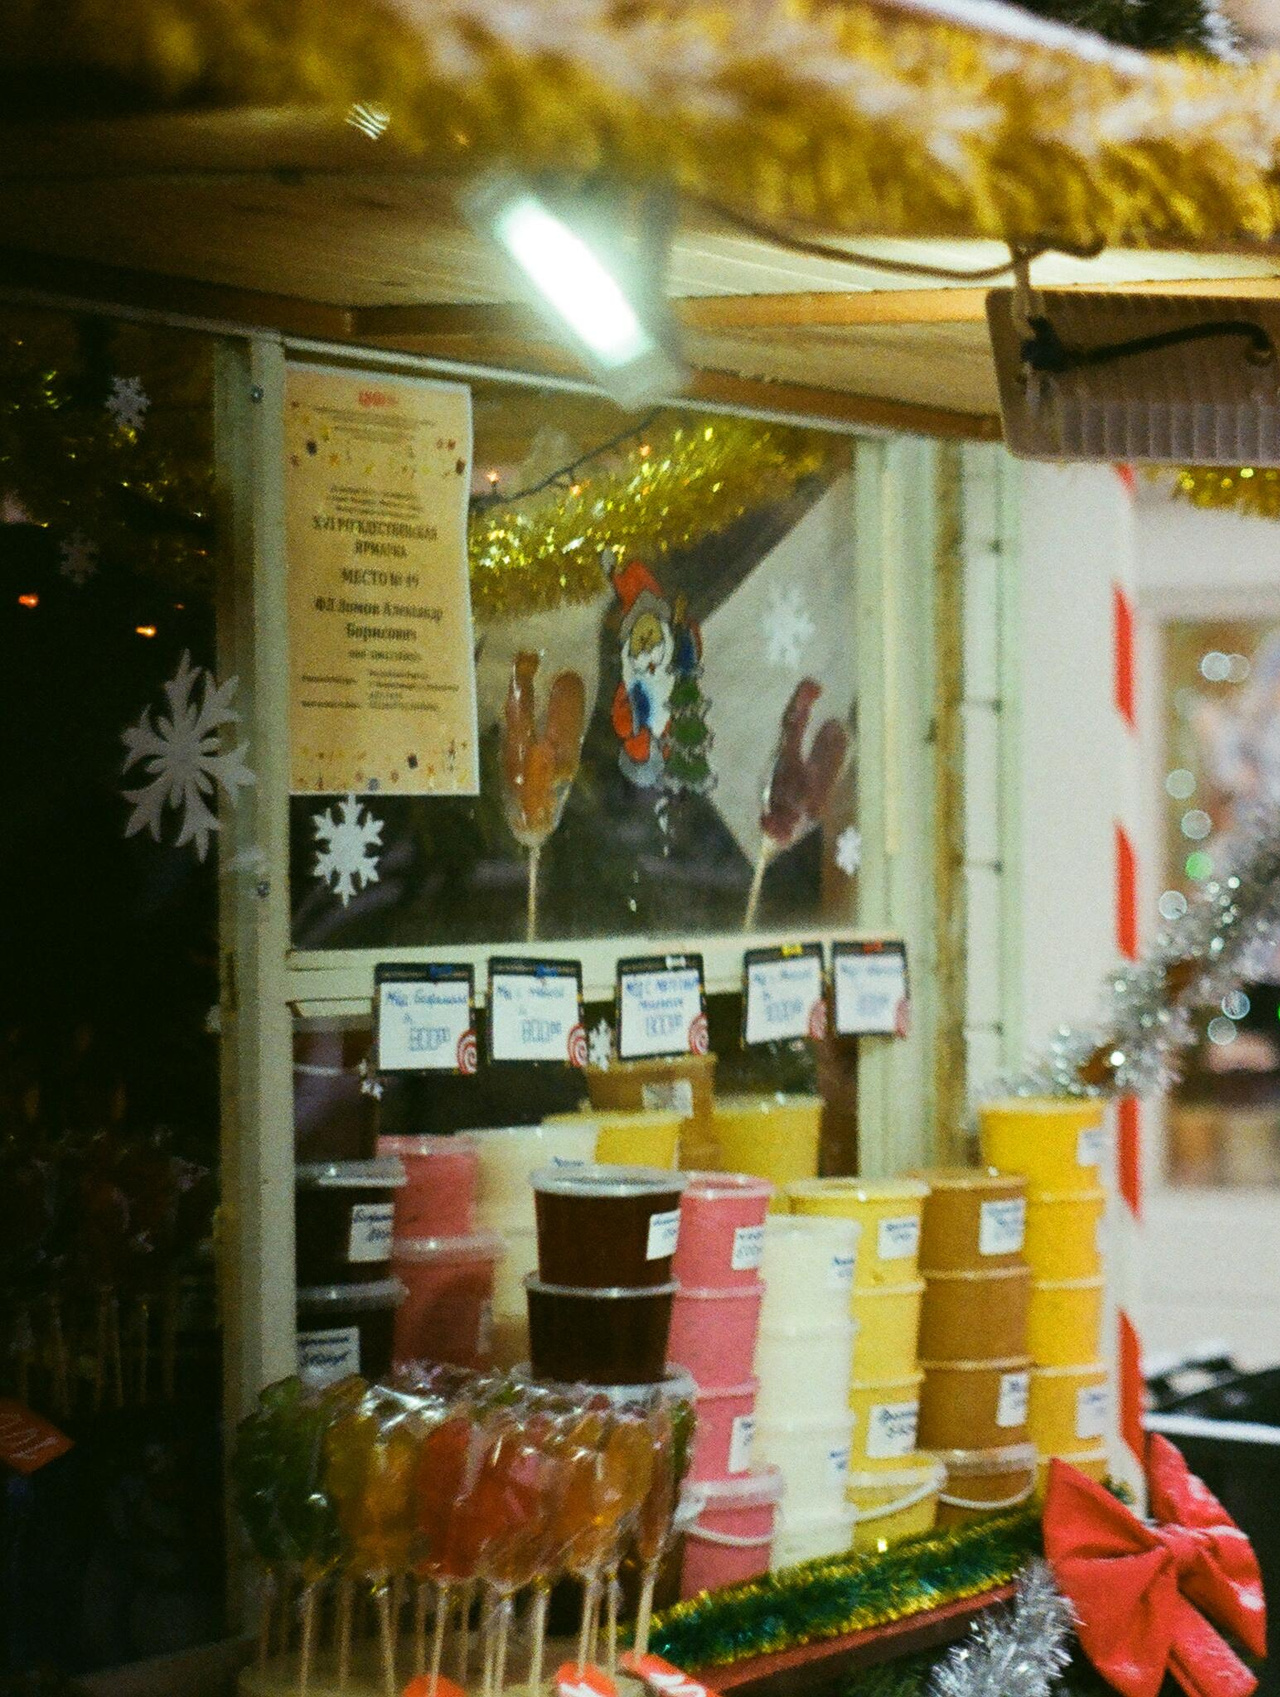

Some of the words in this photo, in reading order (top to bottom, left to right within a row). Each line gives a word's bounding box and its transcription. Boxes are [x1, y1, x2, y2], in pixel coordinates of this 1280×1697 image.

[355, 539, 407, 558] ЯРМАРКА
[341, 567, 387, 587] МЕСТО
[346, 621, 417, 643] Борисович
